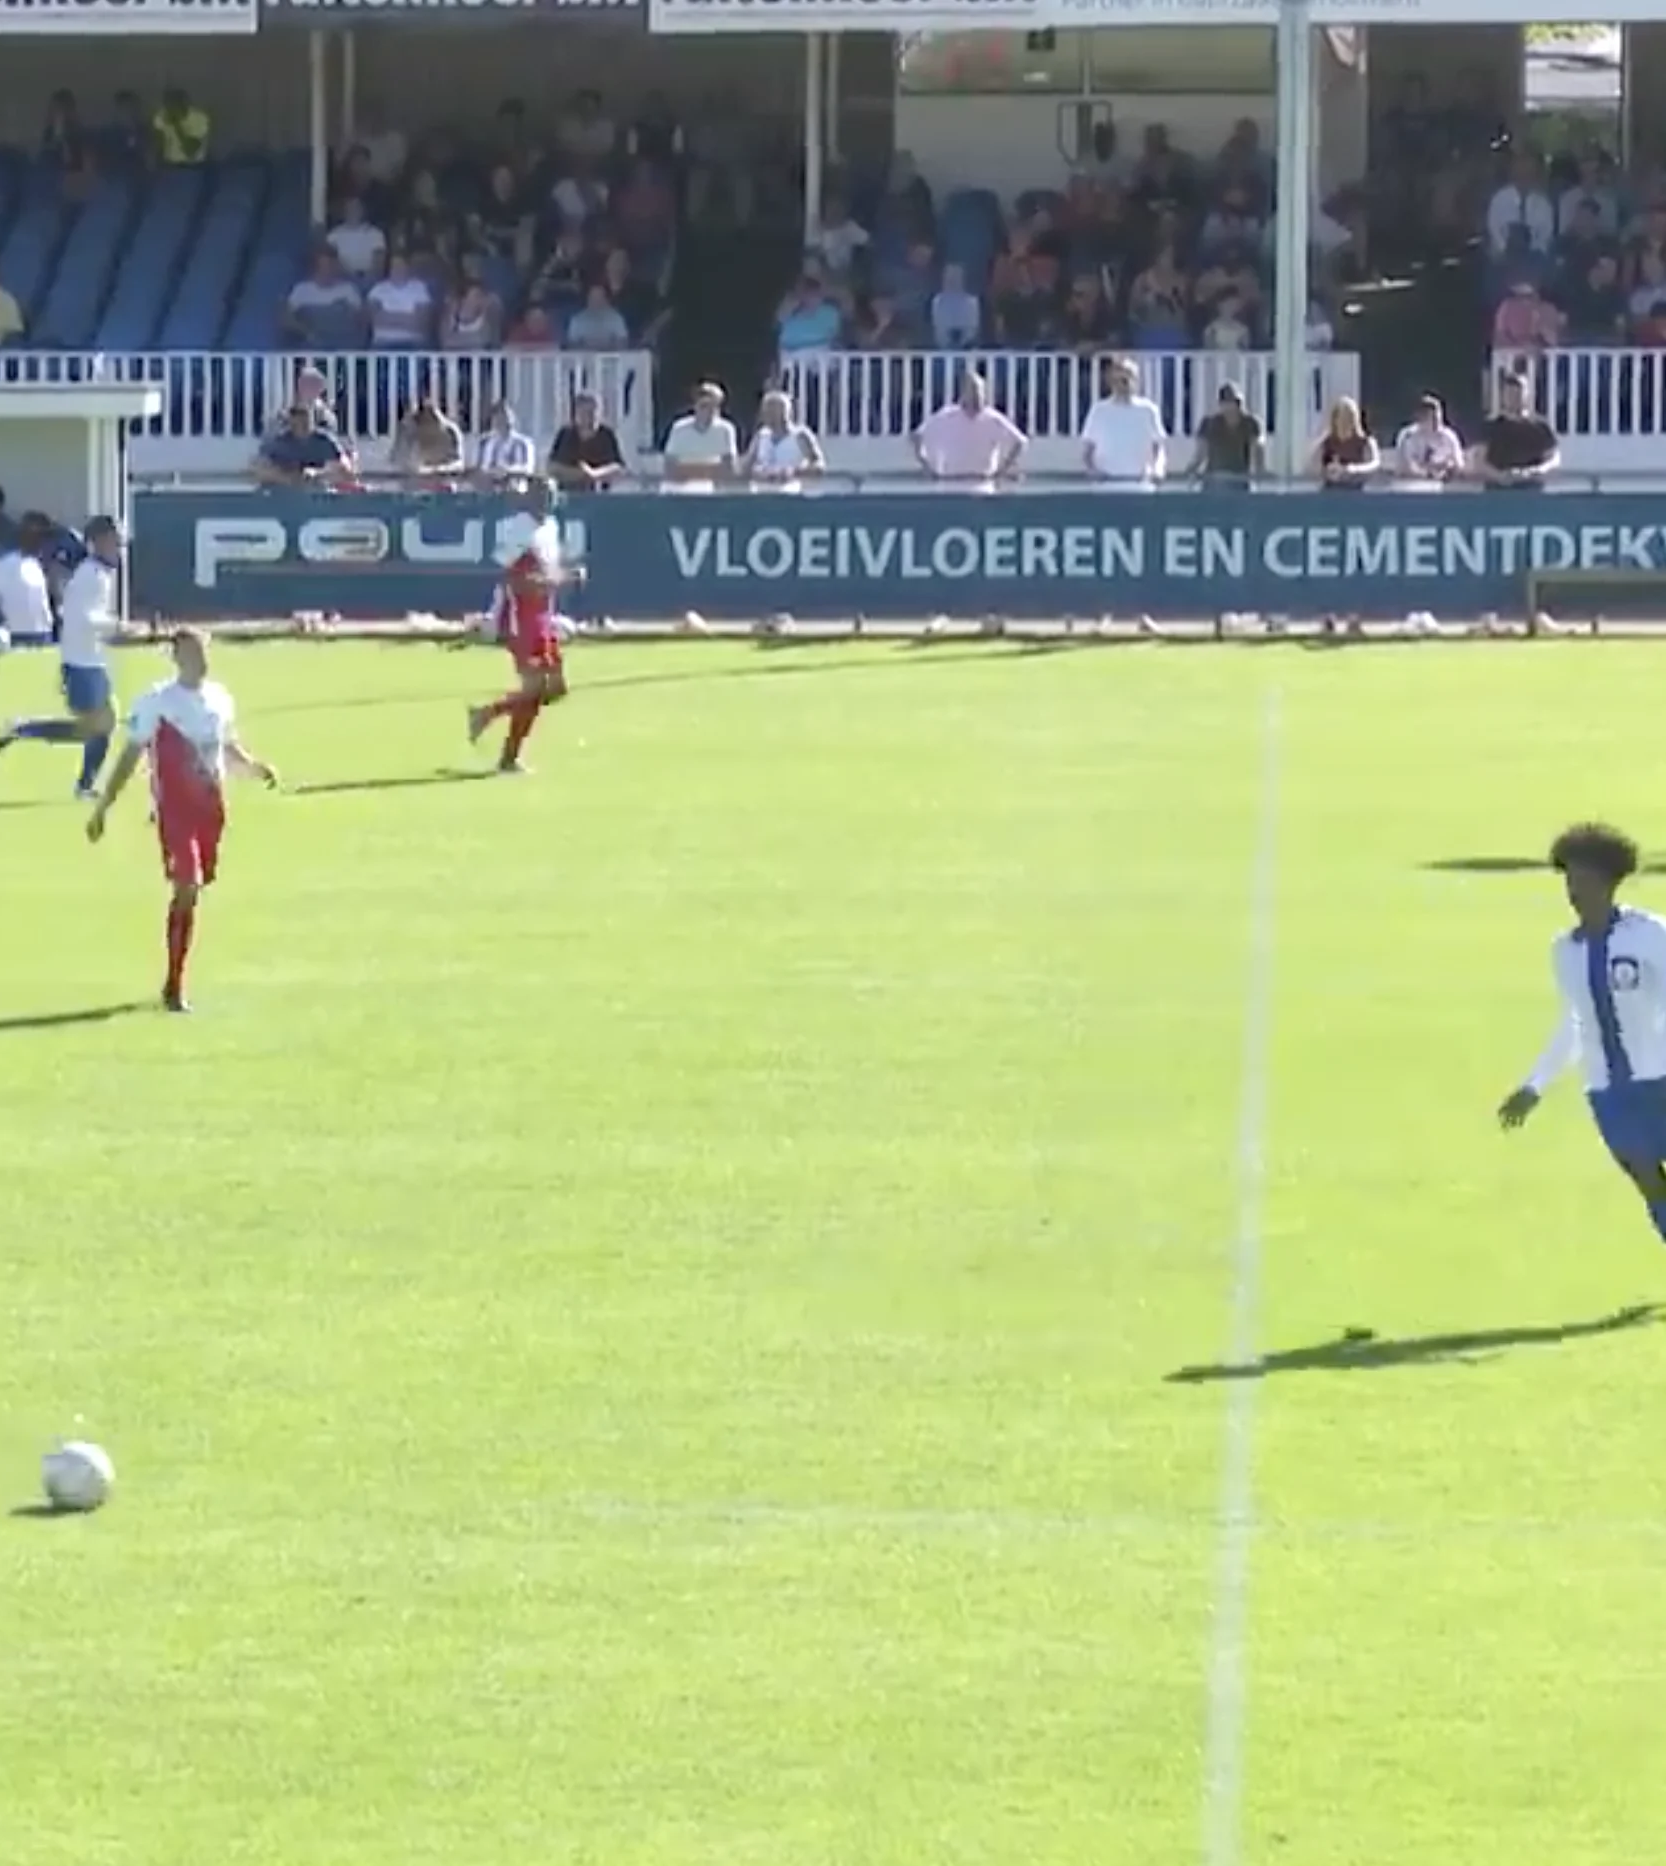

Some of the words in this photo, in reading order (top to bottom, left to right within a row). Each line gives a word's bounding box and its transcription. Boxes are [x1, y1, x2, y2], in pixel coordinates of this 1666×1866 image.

[669, 526, 1144, 578] VLOEIVLOEREN
[1164, 527, 1244, 576] EN
[1262, 525, 1666, 576] CEMENTDEK
